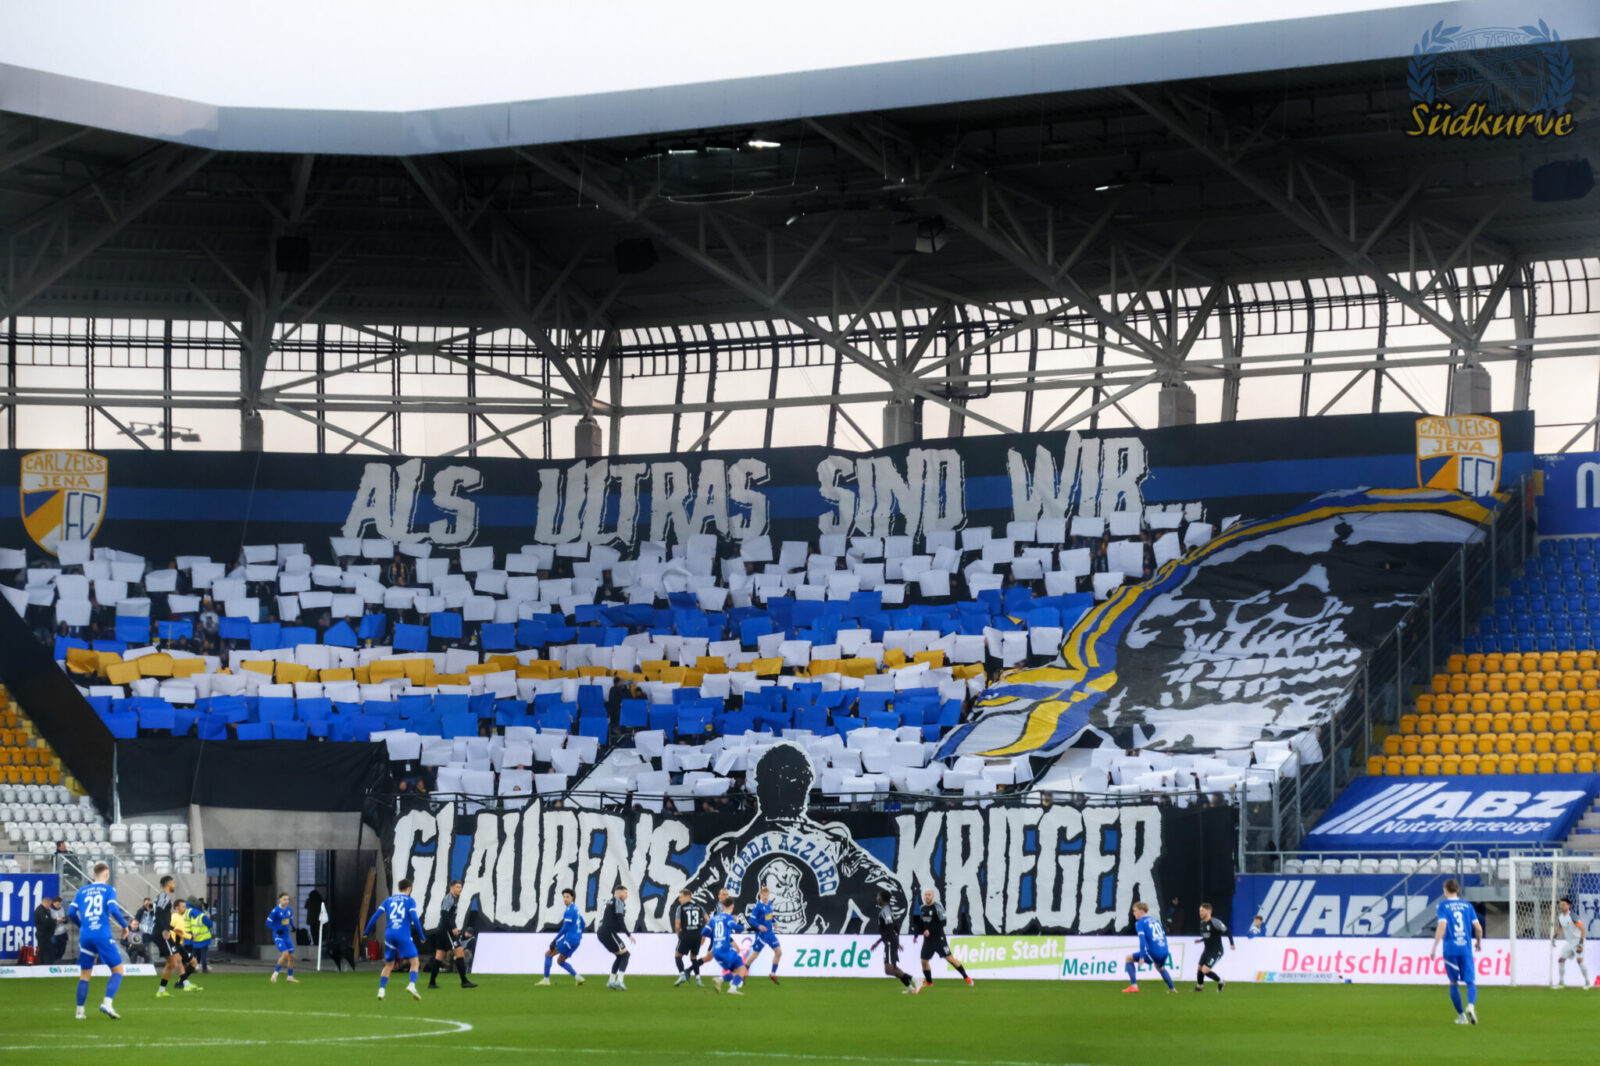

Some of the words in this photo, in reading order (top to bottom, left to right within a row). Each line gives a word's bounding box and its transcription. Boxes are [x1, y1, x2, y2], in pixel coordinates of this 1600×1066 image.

[1432, 440, 1483, 452] JENA
[25, 453, 63, 472] CARL
[64, 452, 104, 472] ZEISS
[38, 476, 90, 488] JENA
[342, 458, 484, 548] ALS
[534, 458, 770, 552] ULTRAS
[817, 447, 967, 543] SIND
[65, 491, 101, 541] FC
[1396, 791, 1587, 819] ABZ
[1372, 819, 1551, 835] Nutzfahrzeuge
[391, 798, 692, 933] GLAUBENS
[895, 804, 1163, 935] KRIEGER
[725, 836, 772, 895] HORDA
[84, 894, 104, 917] 29
[389, 901, 406, 920] 24
[1296, 895, 1429, 935] ABZ
[686, 910, 700, 926] 13
[714, 920, 724, 938] 10
[1453, 911, 1464, 932] 3
[1149, 922, 1162, 939] 20
[793, 940, 872, 969] zar.de
[952, 942, 1007, 963] Meine
[1011, 937, 1063, 960] Stadt.
[1062, 956, 1118, 976] Meine
[1281, 947, 1512, 976] Deutschlaneit
